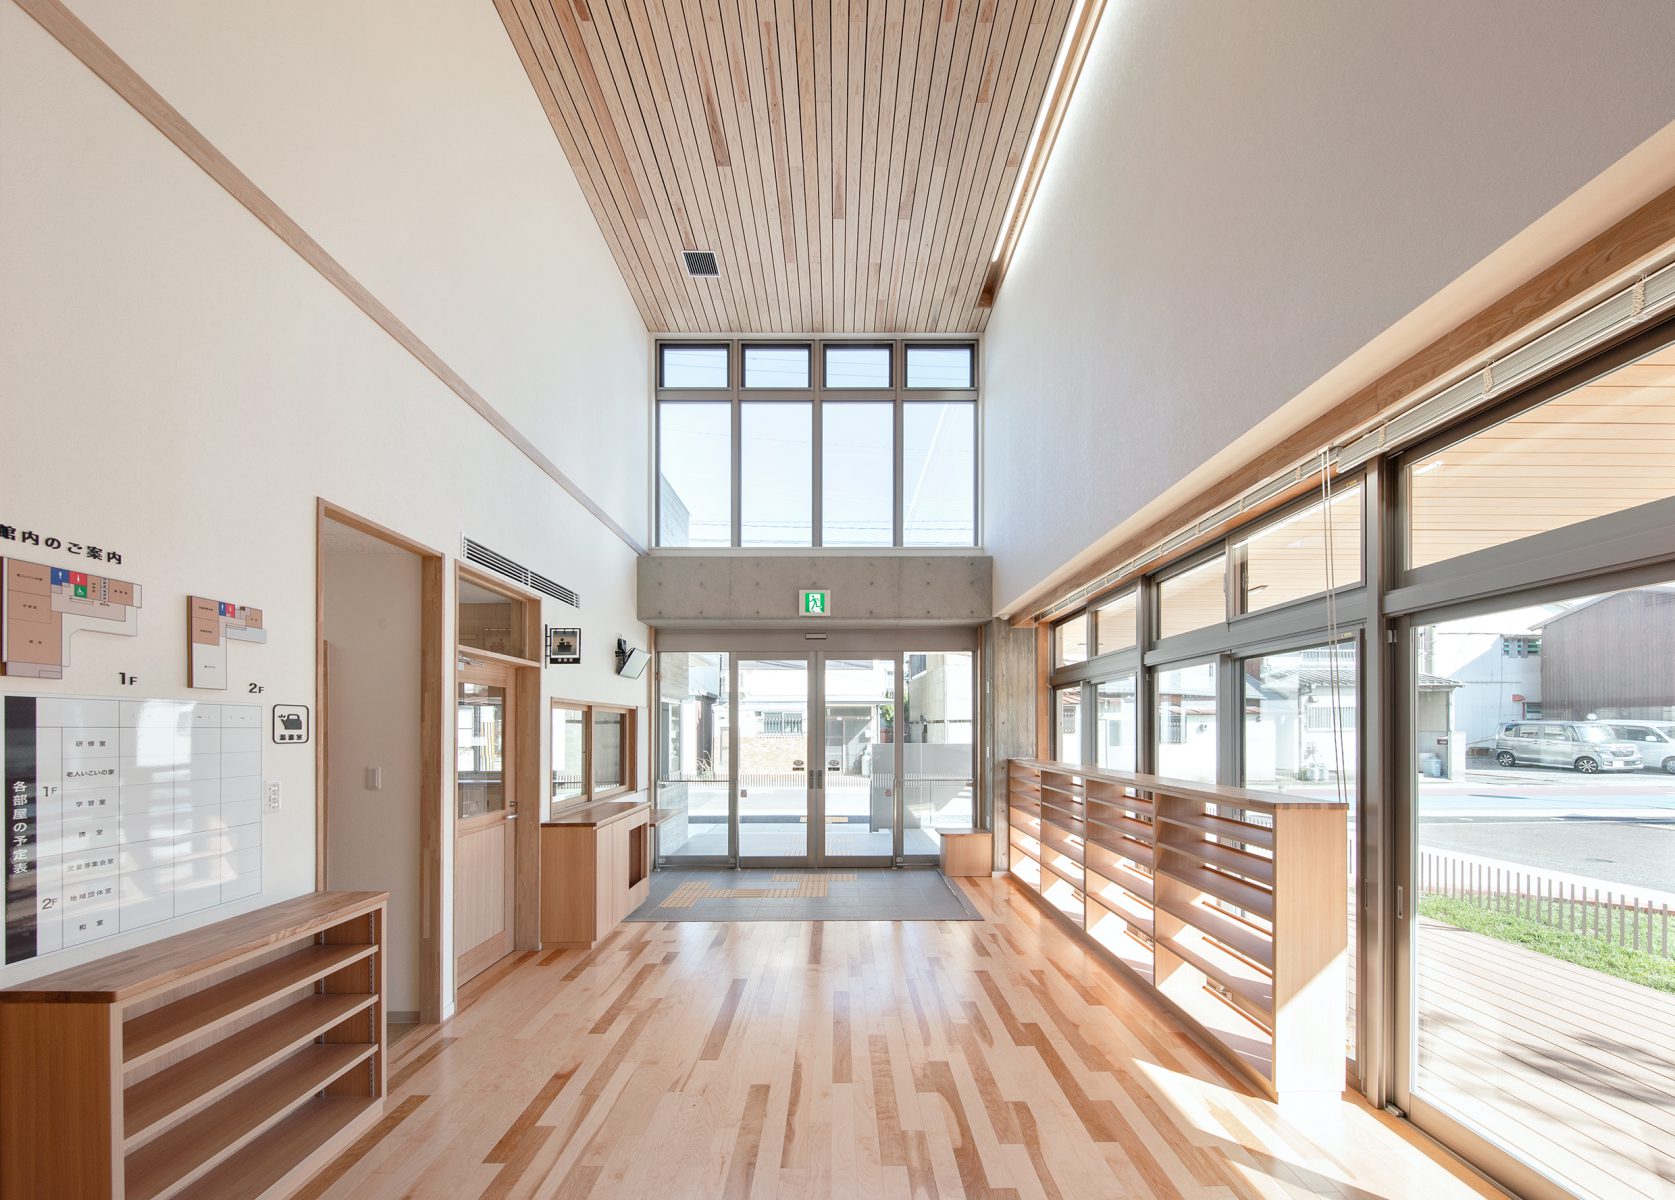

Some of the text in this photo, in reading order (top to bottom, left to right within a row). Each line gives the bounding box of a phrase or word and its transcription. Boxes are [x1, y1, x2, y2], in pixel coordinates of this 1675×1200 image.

[0, 523, 123, 565] 館内のご案内
[118, 671, 138, 686] 1F
[248, 682, 265, 694] 2F
[66, 768, 115, 778] 老人いこいの家
[42, 786, 58, 798] 1F
[12, 780, 28, 875] 各部屋の予定表
[42, 897, 58, 910] 2F
